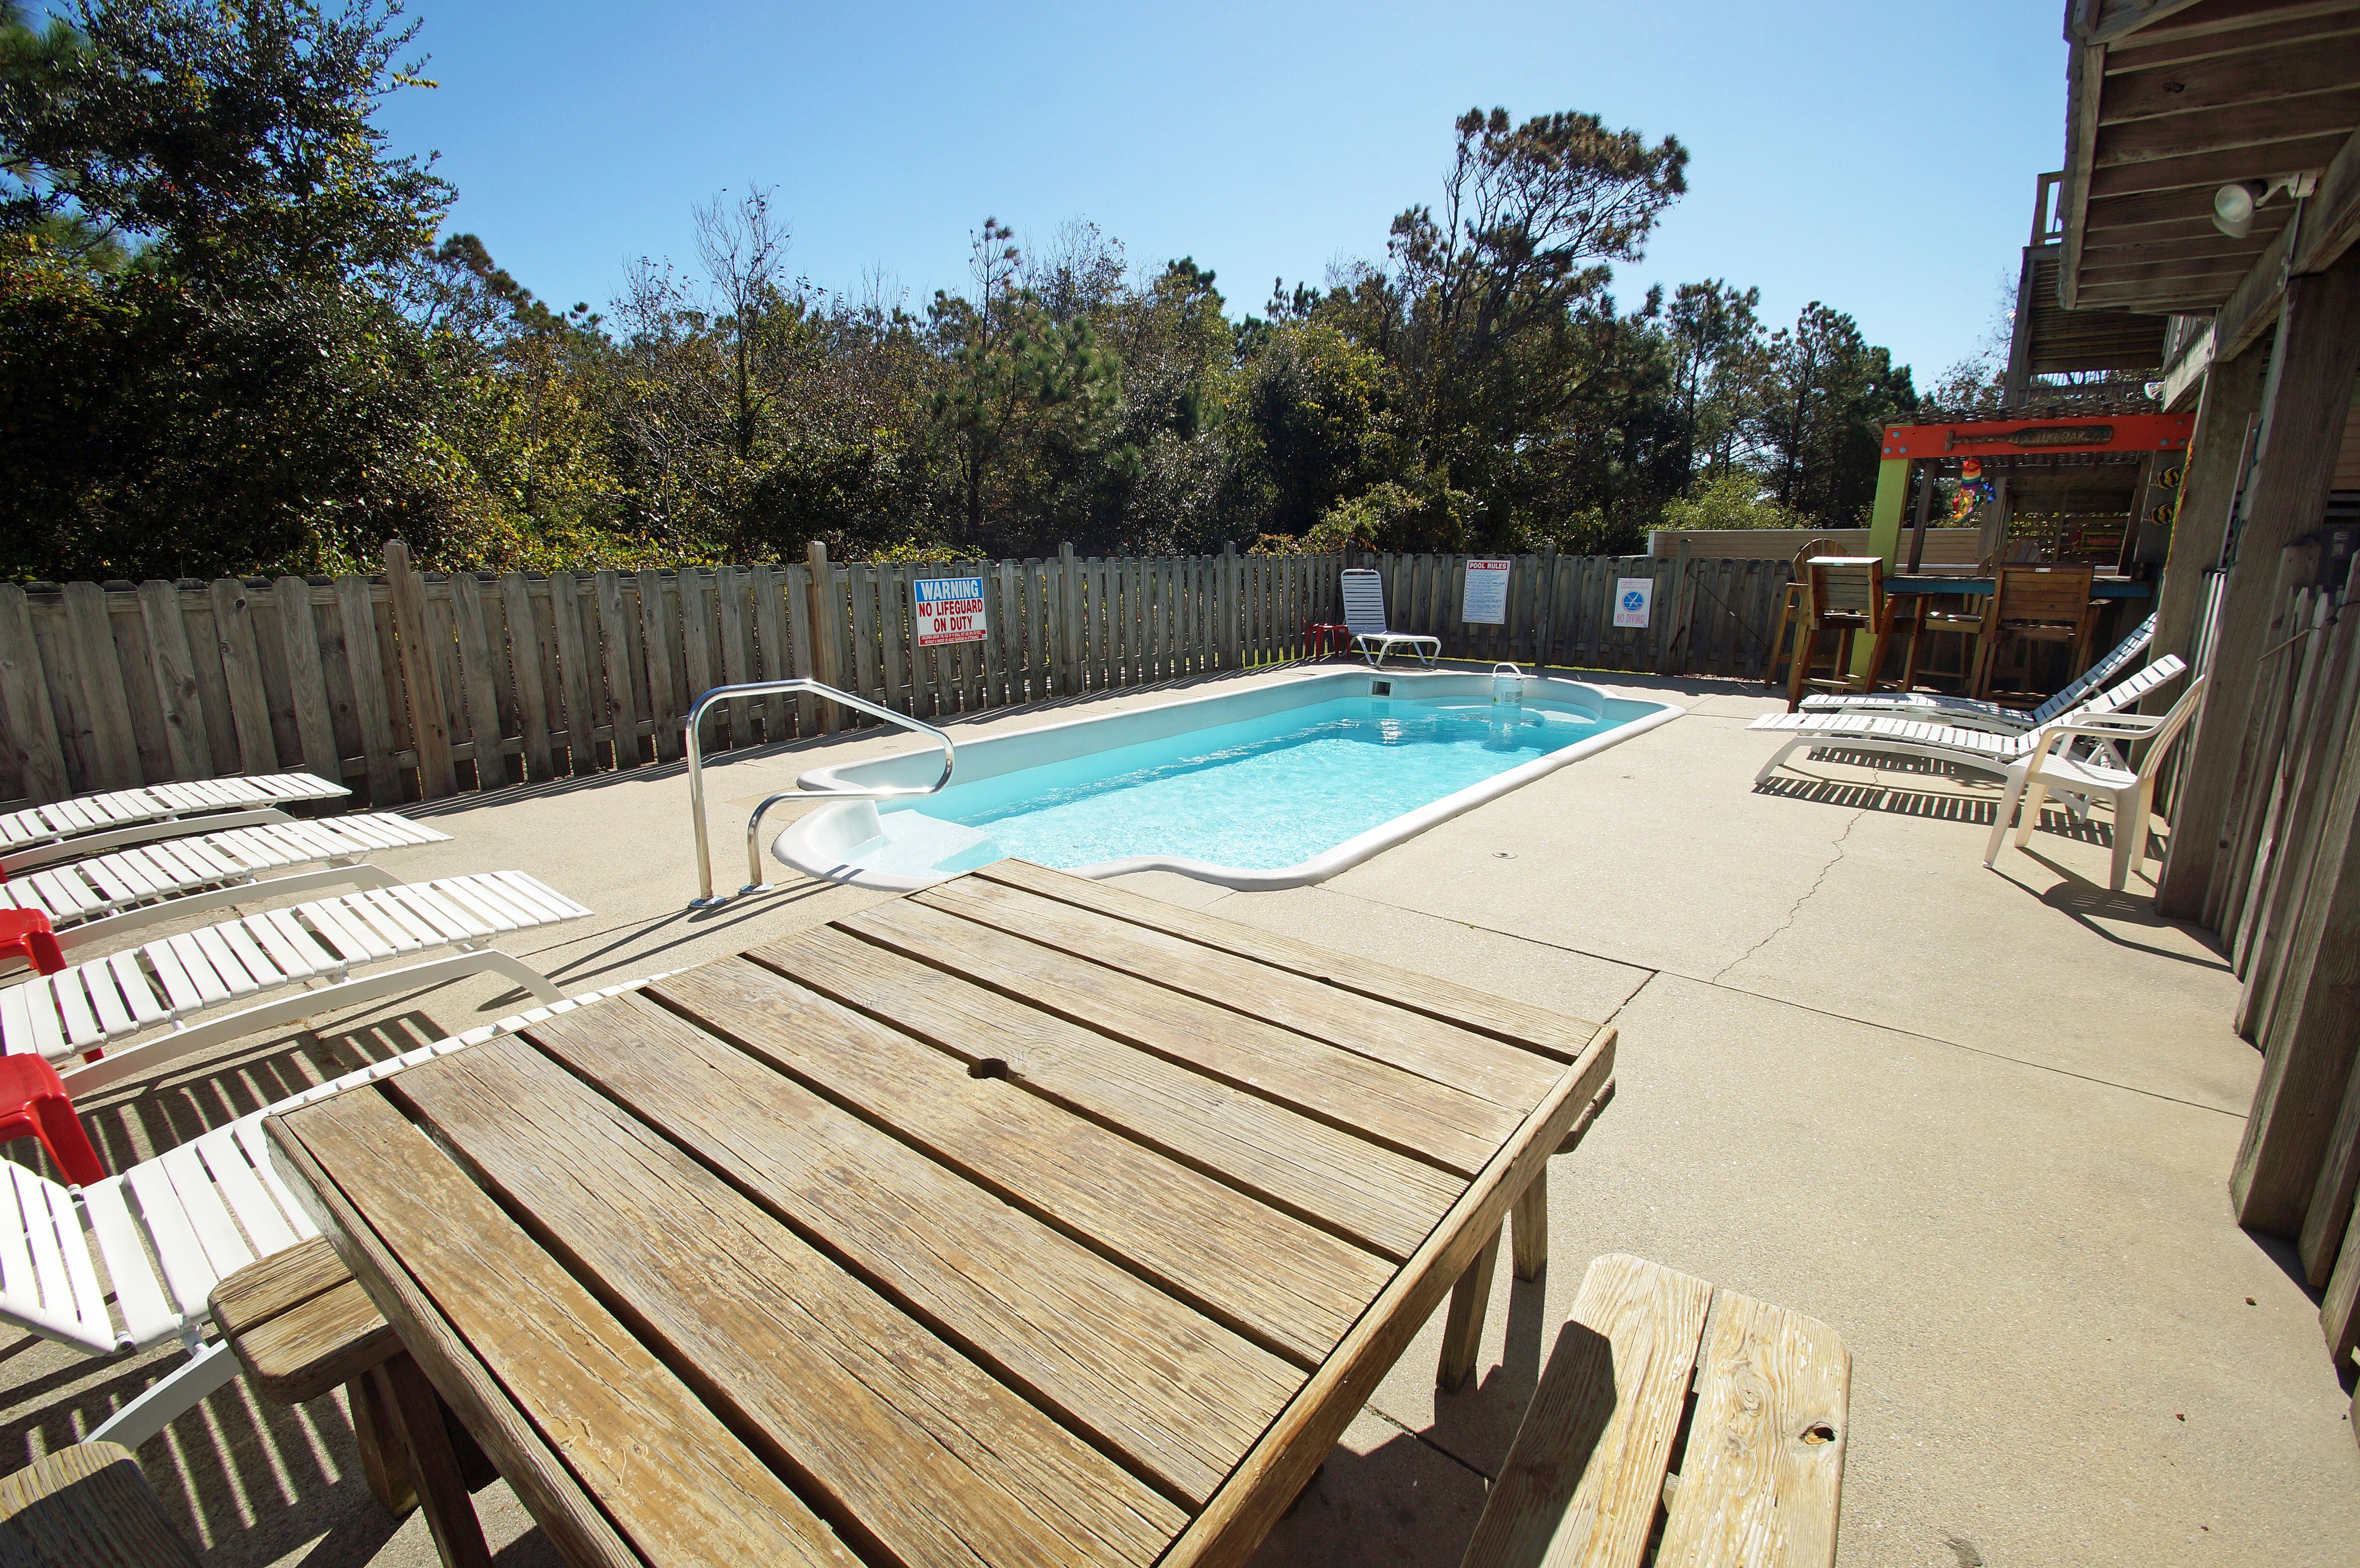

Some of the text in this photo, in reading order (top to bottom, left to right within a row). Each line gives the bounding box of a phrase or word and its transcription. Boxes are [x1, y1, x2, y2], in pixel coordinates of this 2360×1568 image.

[921, 580, 979, 600] WARNING
[919, 599, 983, 617] NO LIFEGUARD
[934, 615, 972, 632] ON DUTY
[1617, 613, 1646, 624] NO DIVING!
